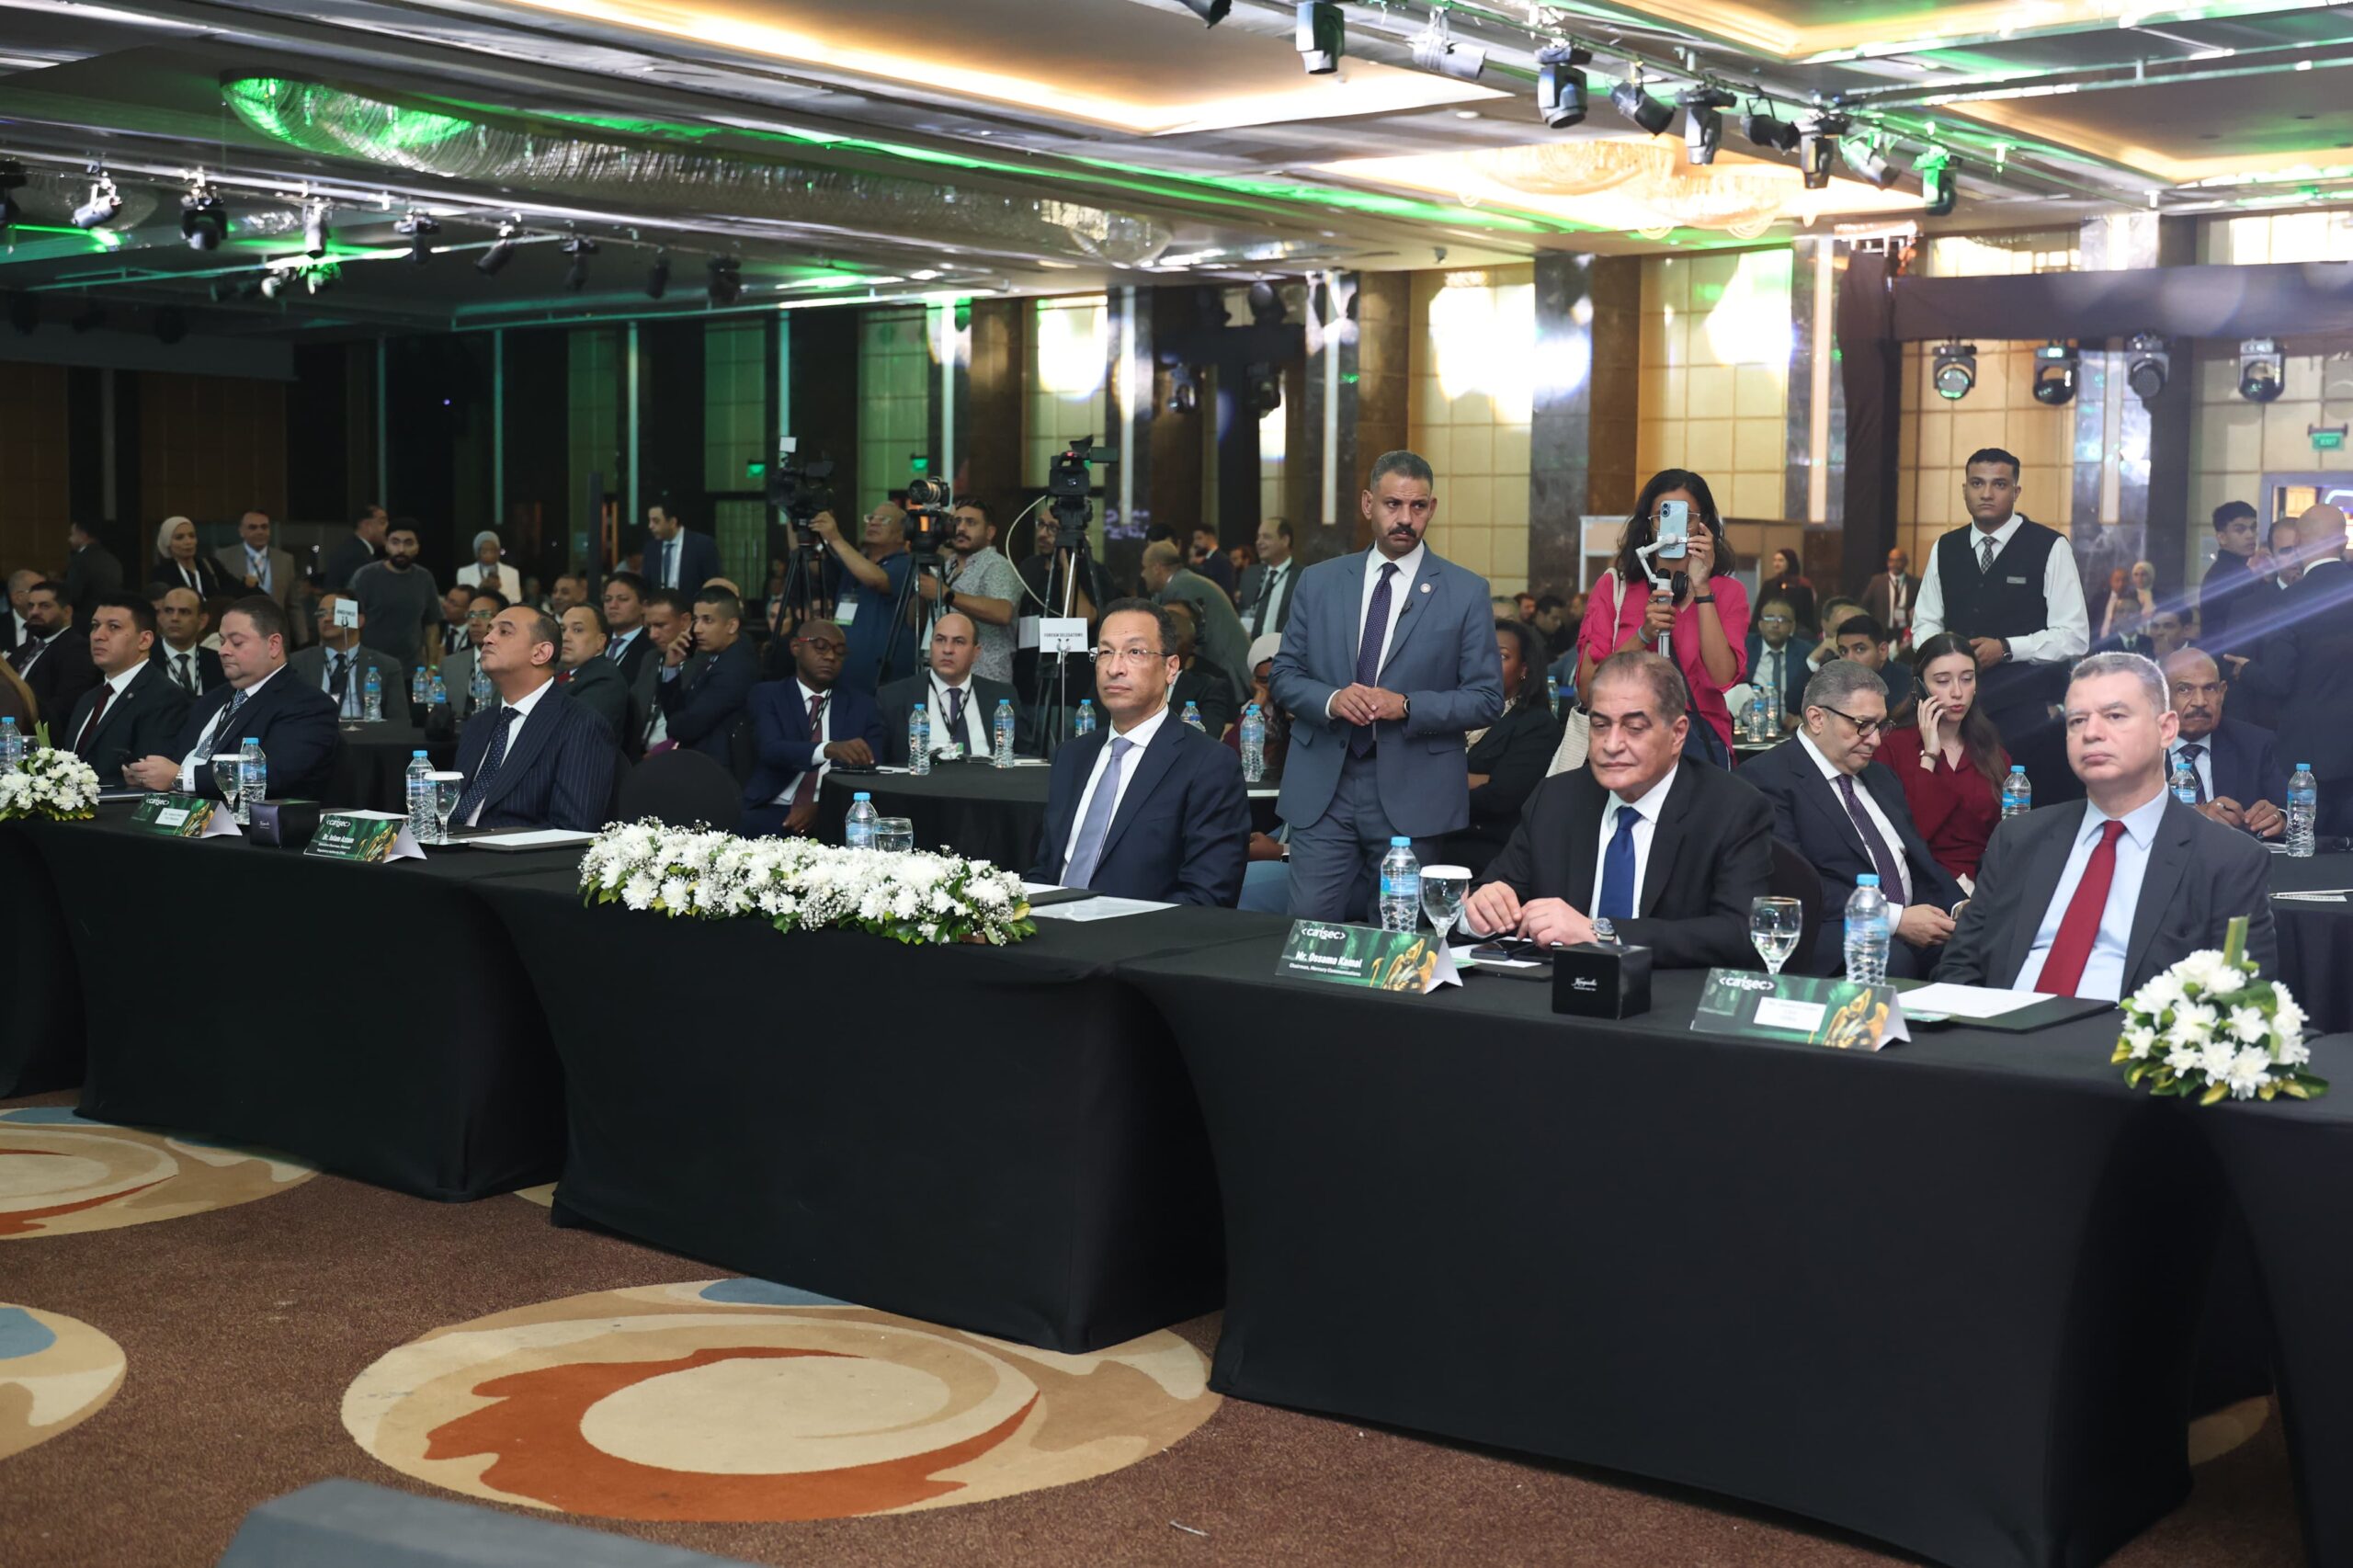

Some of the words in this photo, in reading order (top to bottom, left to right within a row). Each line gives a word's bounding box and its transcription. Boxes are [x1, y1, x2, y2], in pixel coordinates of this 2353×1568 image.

[1295, 950, 1307, 961] Mr.
[1308, 952, 1338, 965] Ossama
[1337, 956, 1363, 969] Kamal
